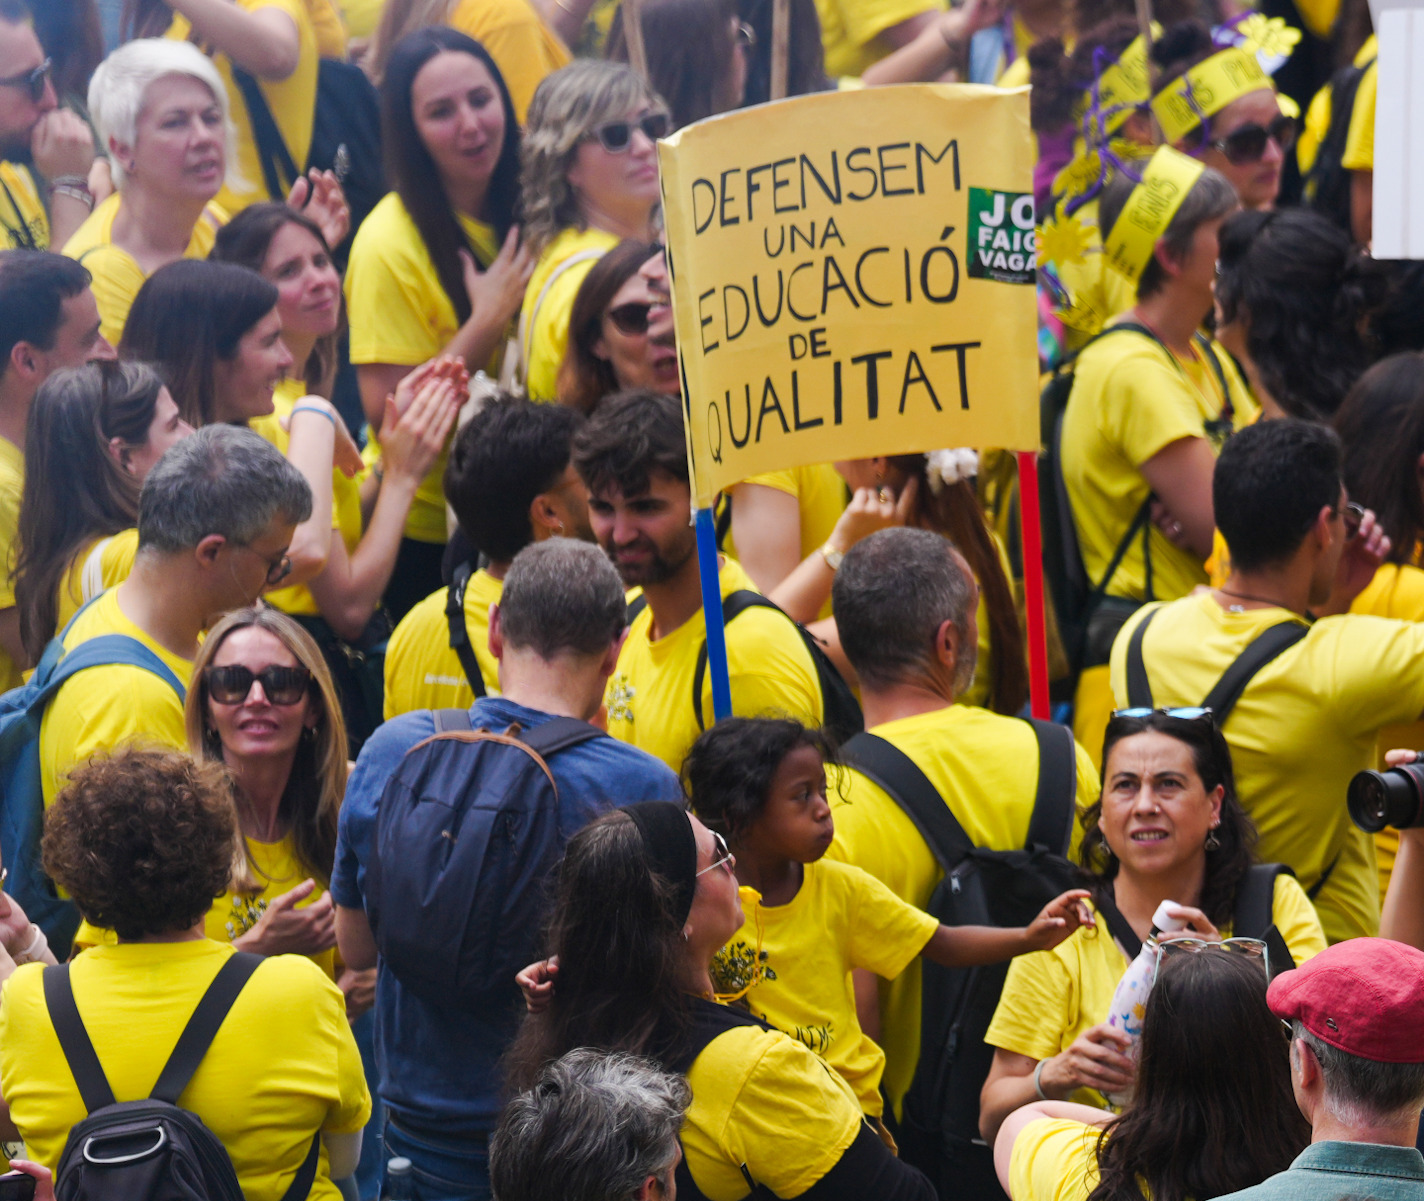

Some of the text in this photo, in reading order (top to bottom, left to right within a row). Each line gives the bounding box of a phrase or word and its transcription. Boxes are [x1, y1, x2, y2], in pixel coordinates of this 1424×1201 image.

[692, 139, 961, 235] DEFENSEM
[979, 193, 1035, 230] JO
[764, 217, 846, 259] UNA
[699, 226, 960, 357] EDUCACIÓ
[789, 327, 832, 361] DE
[707, 341, 981, 465] QUALITAT
